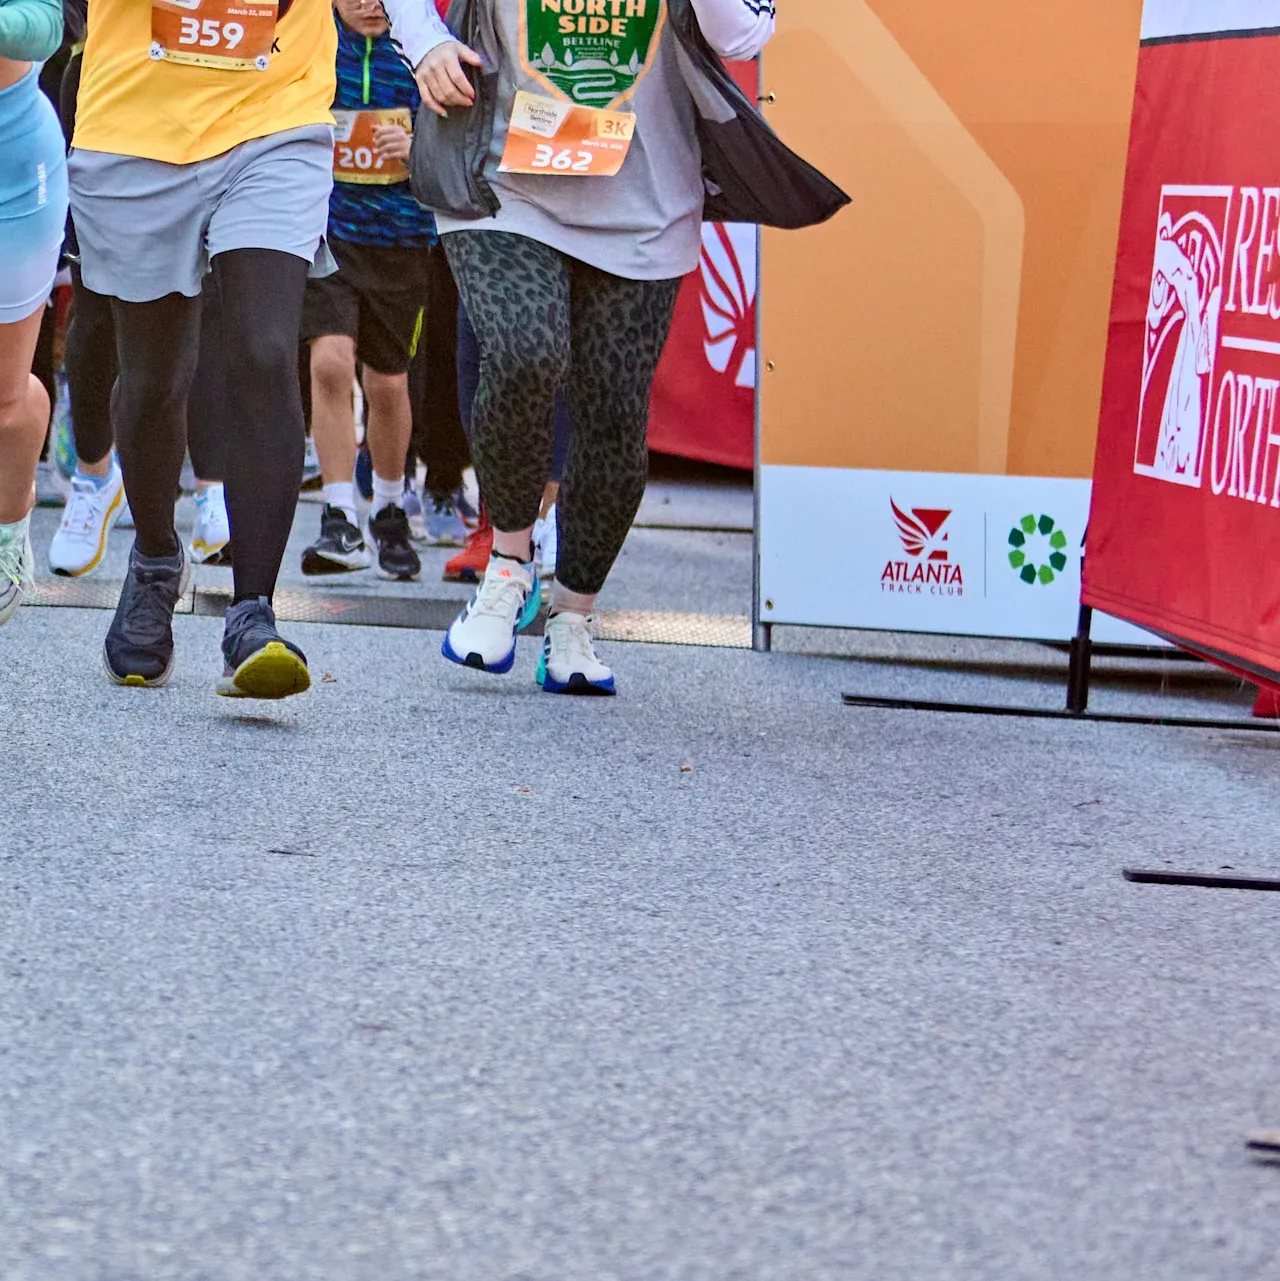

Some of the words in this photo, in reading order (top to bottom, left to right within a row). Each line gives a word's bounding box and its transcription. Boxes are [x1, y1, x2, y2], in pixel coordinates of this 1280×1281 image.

[227, 7, 248, 16] March
[248, 8, 258, 17] 22,
[258, 9, 273, 17] 2025
[178, 16, 245, 50] 359
[557, 15, 629, 38] SIDE
[563, 36, 621, 49] BELTLINE
[527, 105, 558, 118] Northside
[602, 120, 628, 137] 3K
[531, 143, 594, 172] 362
[880, 560, 964, 586] ATLANTA
[880, 582, 922, 594] TRACK
[930, 586, 964, 597] CLUB
